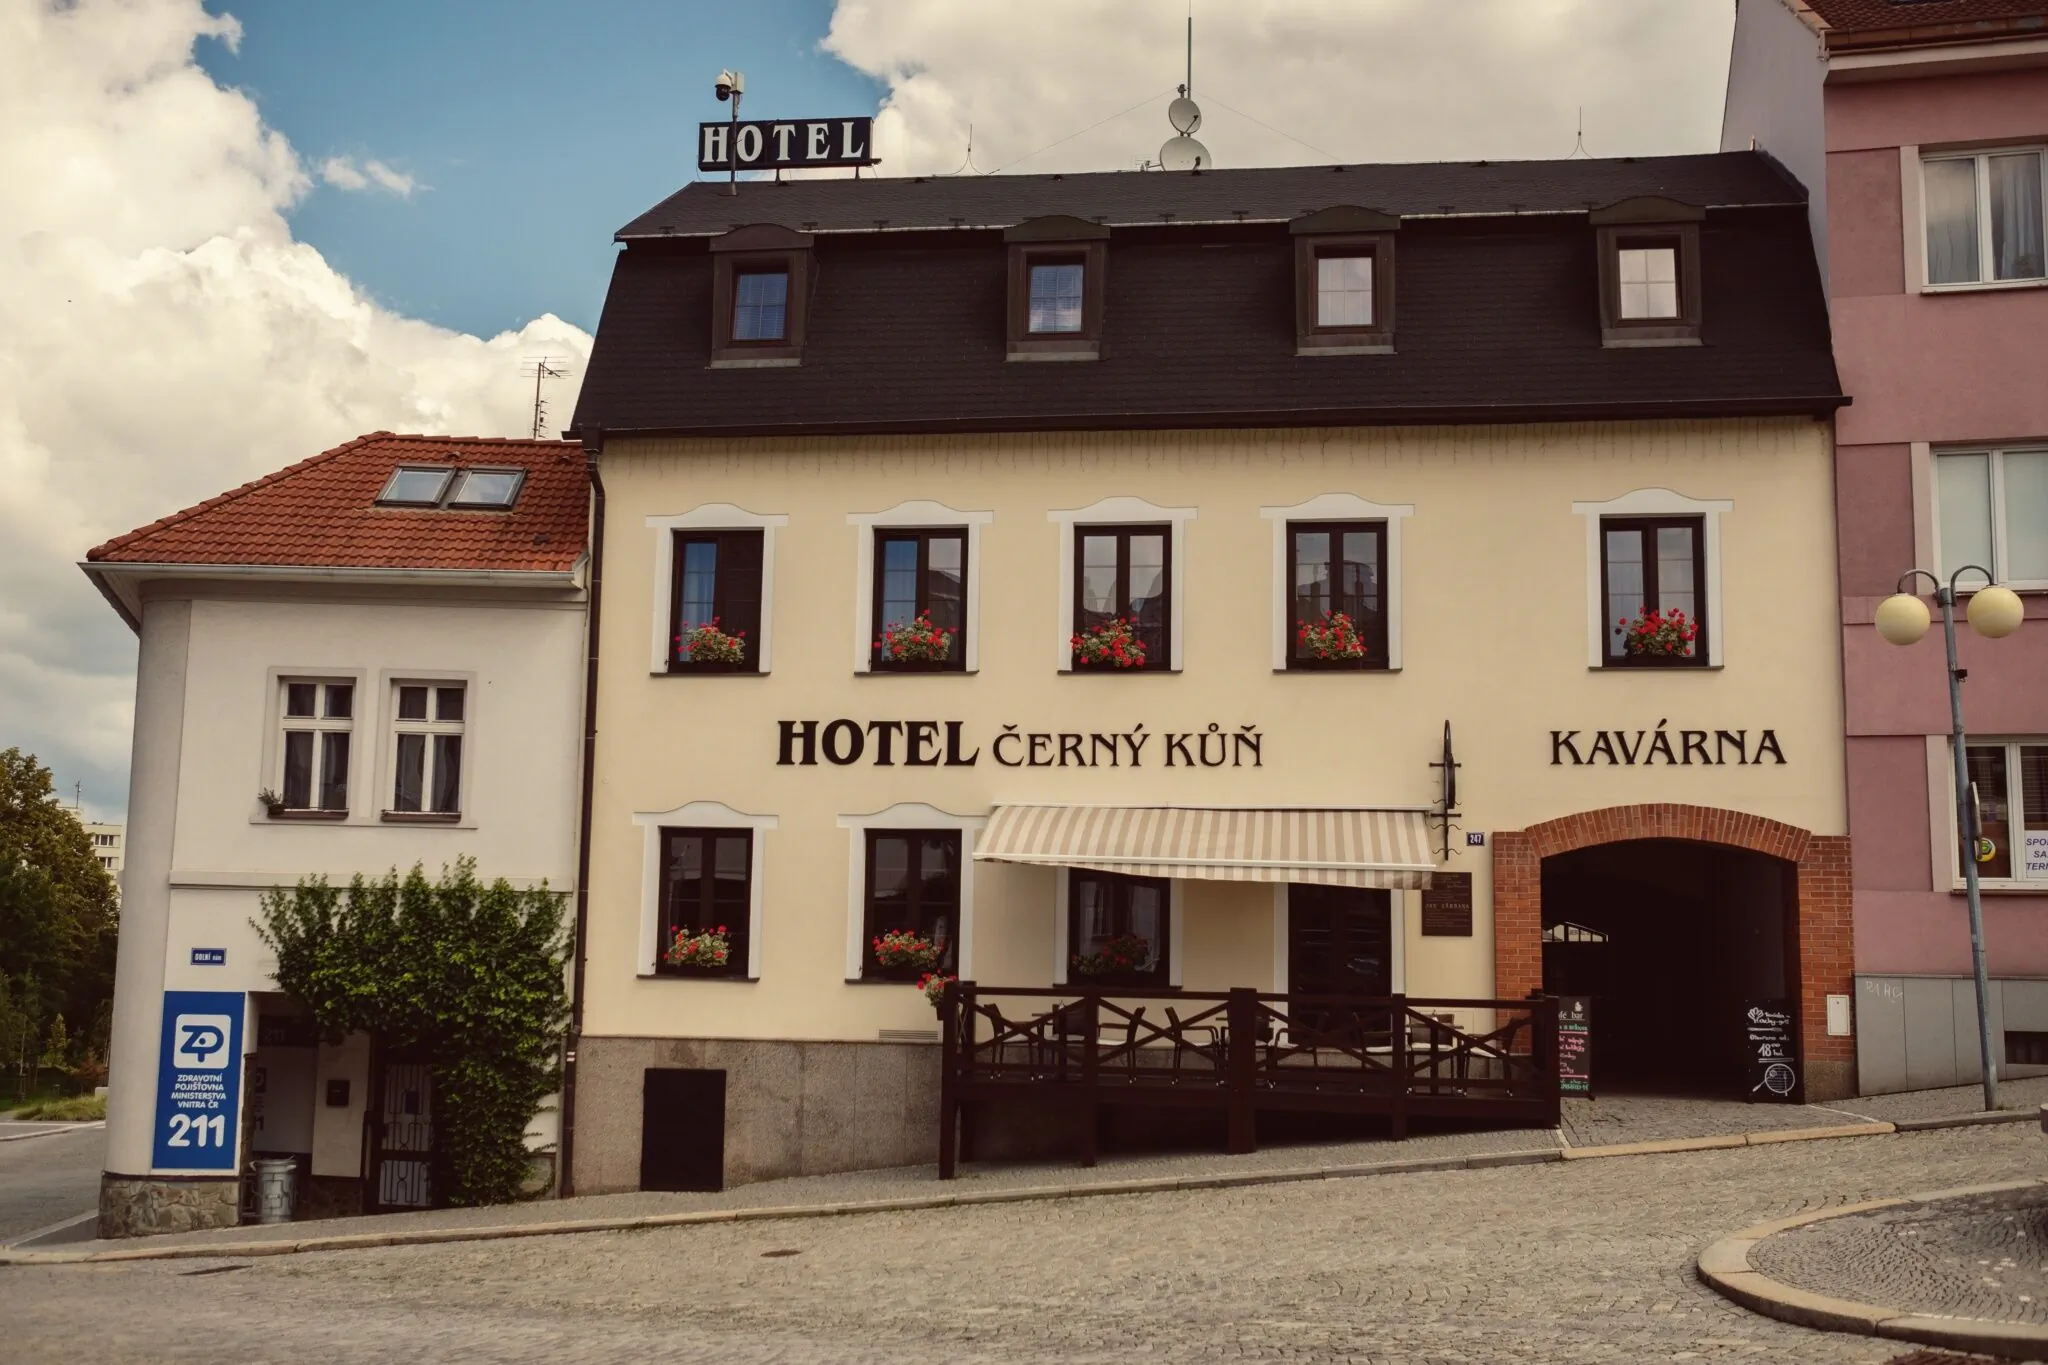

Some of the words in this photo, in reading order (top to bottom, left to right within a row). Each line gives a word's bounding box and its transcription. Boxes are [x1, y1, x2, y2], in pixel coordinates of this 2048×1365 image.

[702, 122, 864, 162] HOTEL
[776, 718, 980, 766] HOTEL
[992, 722, 1152, 767] ČERNÝ
[1164, 722, 1264, 767] KŮŇ
[1549, 718, 1788, 766] KAVÁRNA
[1469, 834, 1482, 844] 247
[2026, 838, 2048, 846] SPO
[2033, 850, 2048, 858] SA
[1757, 1042, 1772, 1057] 18
[177, 1073, 223, 1082] ZDRAVOTNÍ
[174, 1082, 224, 1091] POJIŠŤOVNA
[171, 1091, 227, 1100] MINISTERSTVA
[177, 1101, 206, 1109] VNITRA
[208, 1099, 219, 1109] ČR
[167, 1113, 226, 1148] 211
